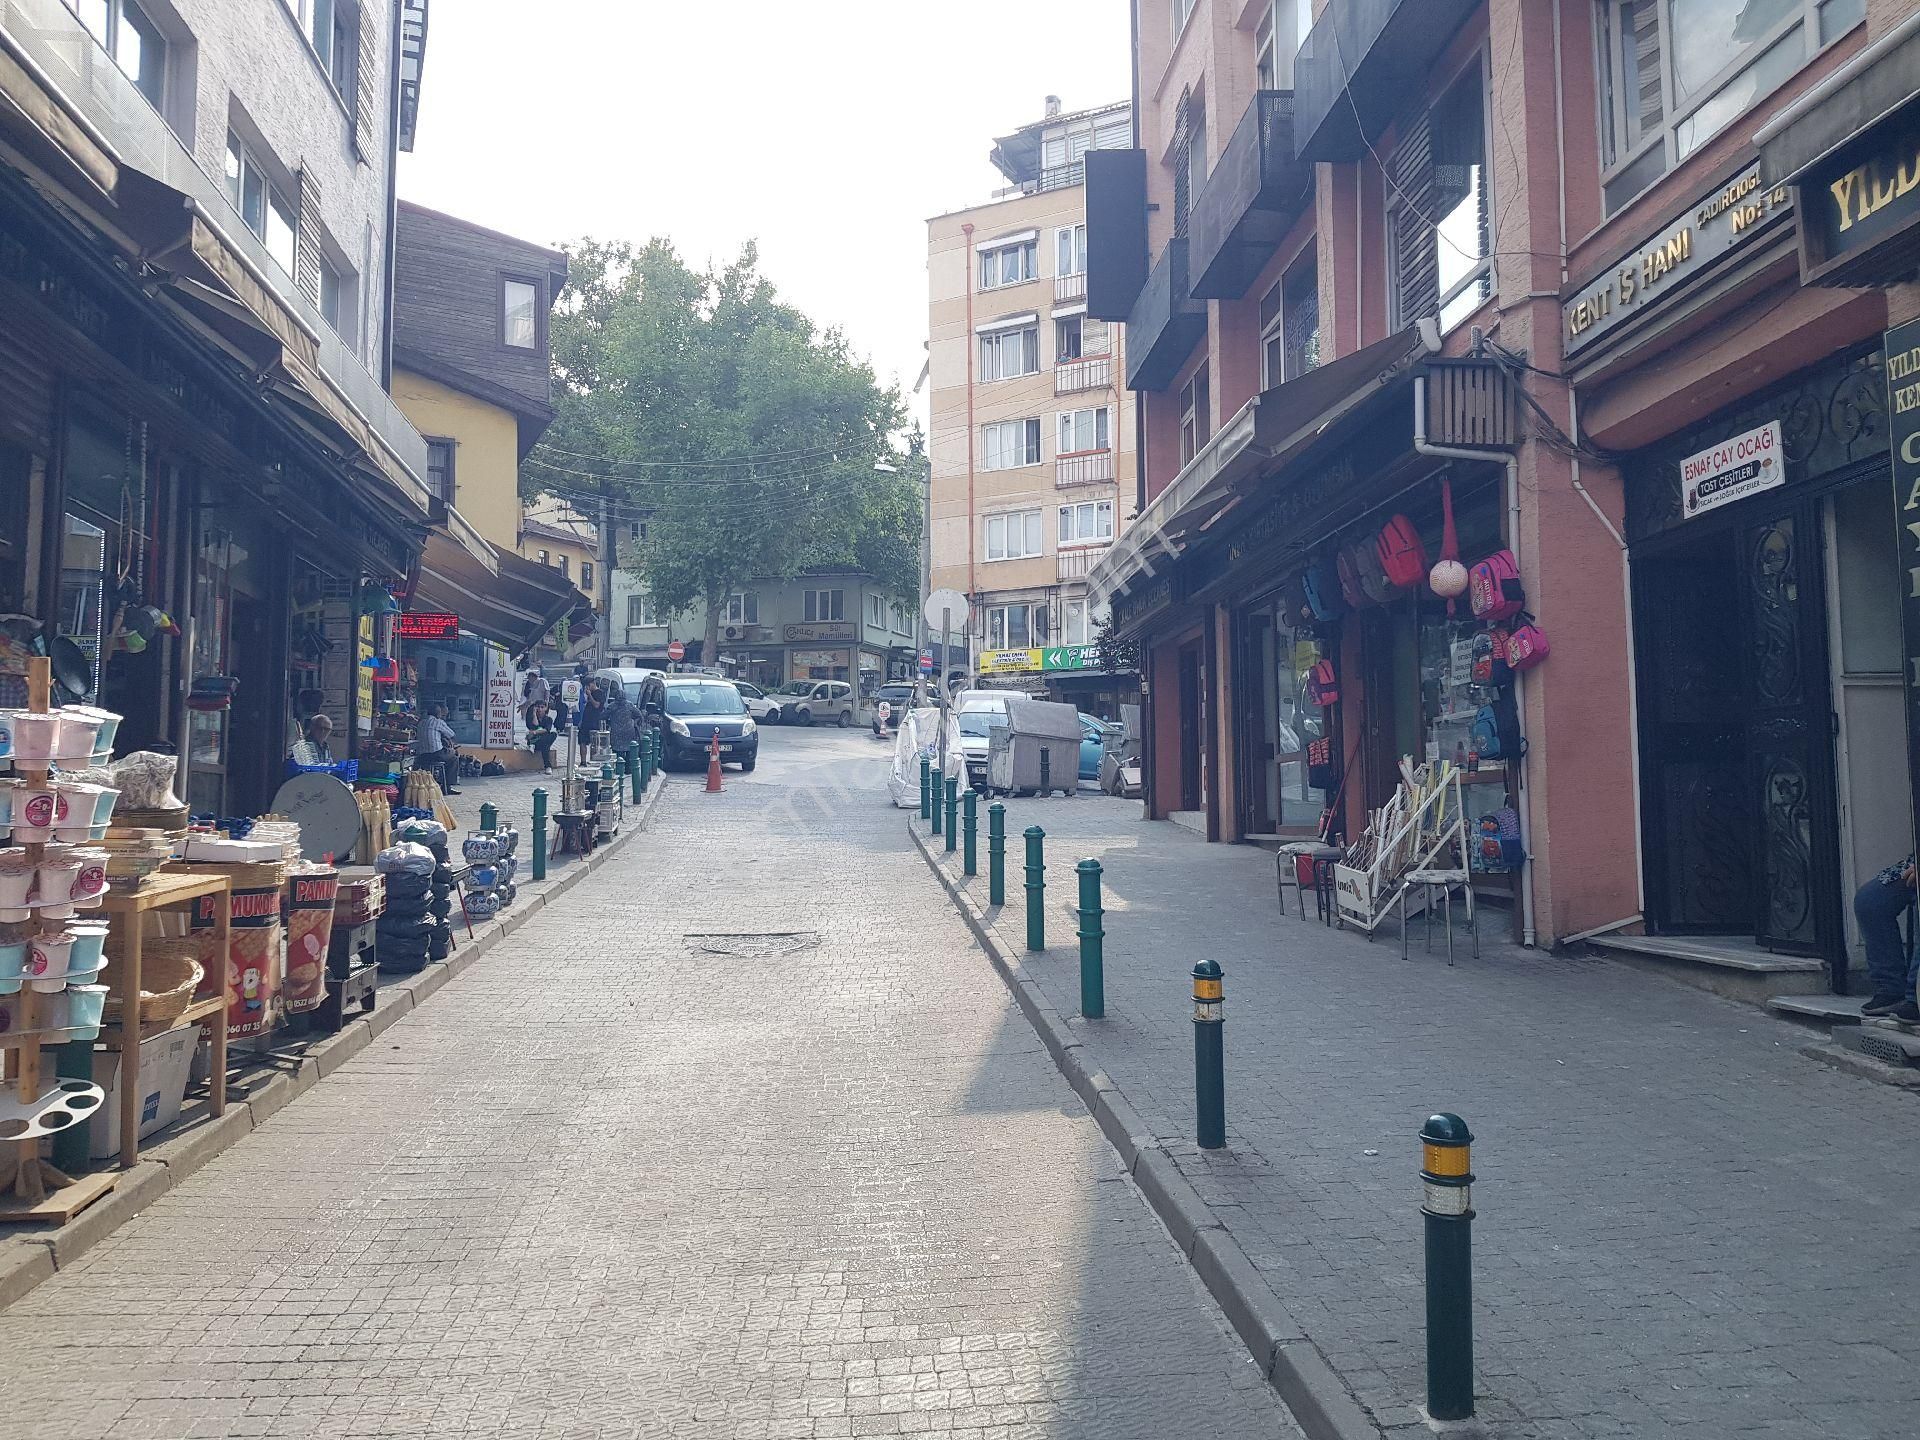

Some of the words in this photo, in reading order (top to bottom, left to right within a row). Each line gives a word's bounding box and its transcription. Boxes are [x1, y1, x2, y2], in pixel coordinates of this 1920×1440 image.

[1568, 285, 1613, 340] KENT
[1640, 228, 1692, 289] HANI
[1684, 456, 1711, 482] ESNAF
[1713, 445, 1734, 472] ÇAY
[1736, 428, 1775, 460] OCAĞI
[1700, 480, 1718, 495] TOST
